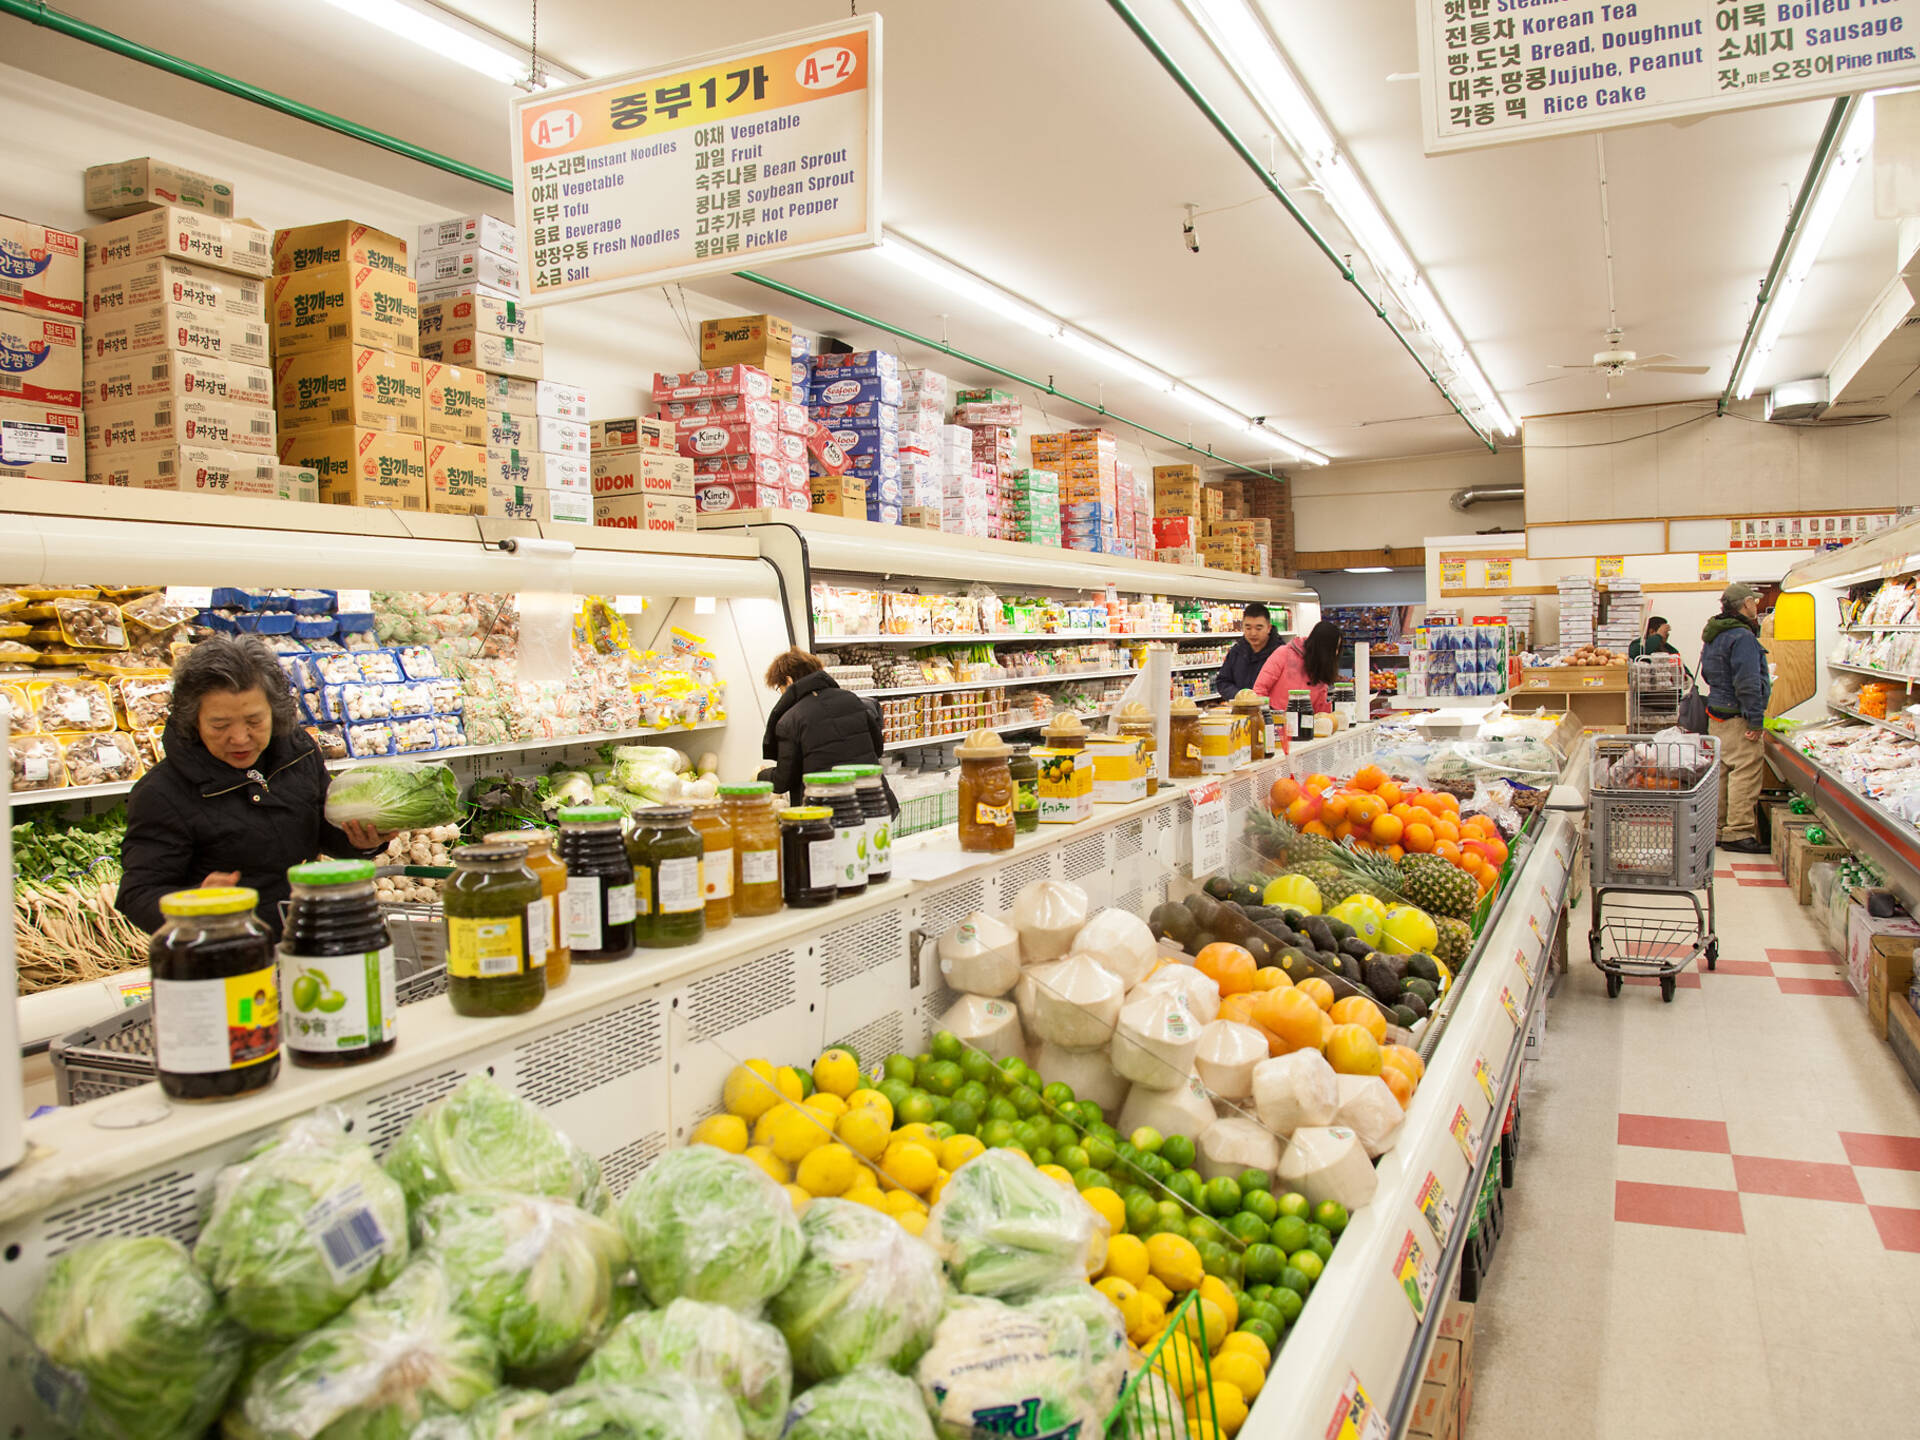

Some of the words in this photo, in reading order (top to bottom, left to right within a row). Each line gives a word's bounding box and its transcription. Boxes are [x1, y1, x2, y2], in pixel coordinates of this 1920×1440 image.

[1445, 18, 1516, 49] 전통차
[1523, 10, 1594, 35] Korean
[1601, 3, 1637, 22] Tea
[1716, 3, 1766, 32] 어묵
[1531, 36, 1595, 61] Bread,
[1602, 19, 1702, 50] Doughnut
[1718, 27, 1794, 62] 소세지
[1806, 15, 1903, 47] Sausage
[804, 51, 850, 85] A-2
[1548, 61, 1622, 86] Jujube,
[1629, 47, 1703, 74] Peanut
[1836, 54, 1872, 71] Pine
[611, 66, 769, 131] 중부1가
[1450, 102, 1495, 128] 각종
[1505, 97, 1527, 119] 떡
[1543, 95, 1588, 115] Rice
[1596, 85, 1647, 106] Cake
[537, 113, 574, 144] A-1
[694, 126, 725, 147] 야채
[730, 115, 800, 140] Vegetable
[531, 155, 586, 181] 박스라면
[586, 151, 627, 171] Instant
[630, 142, 677, 162] Noodles
[695, 149, 725, 170] 과일
[731, 145, 762, 162] Fruit
[696, 164, 757, 191] 숙주나물
[763, 160, 796, 178] Bean
[800, 148, 847, 171] Sprout
[532, 184, 559, 203] 야채
[562, 173, 625, 197] Vegetable
[696, 189, 741, 214] 콩나물
[747, 181, 803, 204] Soybean
[808, 170, 855, 192] Sprout
[533, 205, 559, 225] 두부
[563, 203, 589, 219] Tofu
[696, 208, 756, 236] 고추가루
[762, 207, 785, 223] Hot
[789, 196, 839, 218] Pepper
[534, 226, 560, 246] 음료
[565, 218, 622, 239] Beverage
[695, 233, 740, 258] 절임류
[746, 229, 788, 249] Pickle
[189, 239, 223, 258] 짜장면
[535, 241, 589, 267] 냉장우동
[593, 238, 626, 255] Fresh
[630, 227, 680, 249] Noodles
[537, 269, 562, 288] 소금
[568, 266, 590, 282] Salt
[183, 289, 216, 307] 짜장면
[294, 290, 344, 316] 참깨라면
[374, 291, 417, 319] 참깨라면
[188, 334, 220, 351] 짜장면
[195, 379, 226, 396] 짜장면
[298, 375, 347, 399] 참깨라면
[376, 374, 421, 399] 참깨라면
[443, 387, 485, 410] 참깨라면
[826, 385, 858, 396] Seafood
[196, 425, 228, 441] 짜장면
[699, 431, 725, 442] Kimchi
[379, 456, 424, 478] 참깨라면
[447, 467, 487, 488] 참깨라면
[595, 474, 633, 492] UDON
[645, 477, 671, 489] UDON
[703, 490, 730, 500] Kimchi
[598, 516, 637, 529] UDON
[649, 519, 675, 531] UDON
